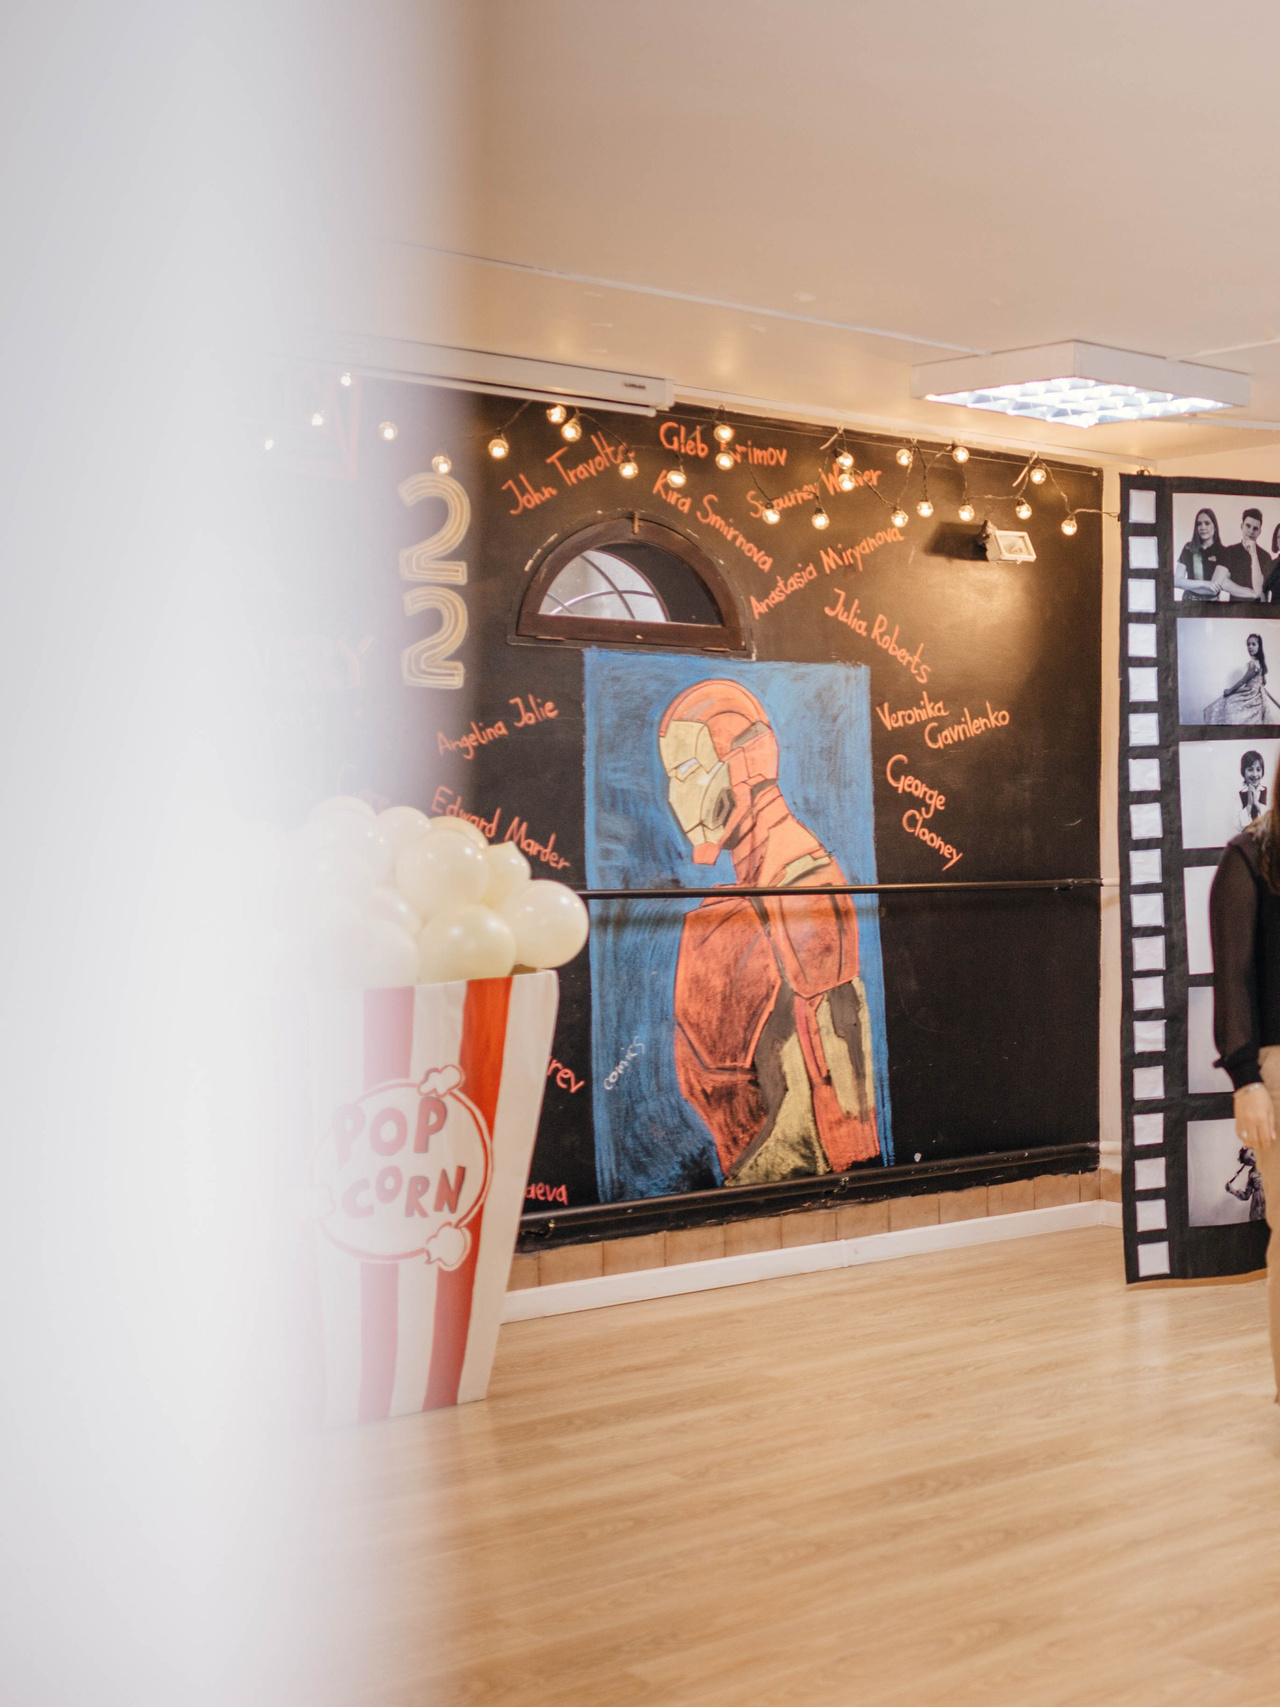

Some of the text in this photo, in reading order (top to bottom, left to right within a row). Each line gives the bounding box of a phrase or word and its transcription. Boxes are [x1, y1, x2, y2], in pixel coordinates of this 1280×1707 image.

[501, 431, 636, 515] John Travolta
[659, 421, 788, 467] Gleb rimov
[818, 463, 882, 496] Wver
[652, 469, 773, 573] Kira Smirnova
[750, 526, 904, 620] Anastasia Miryanova
[824, 588, 931, 684] Julia Roberts
[437, 694, 559, 760] Angelina Jolie
[876, 691, 949, 731] Veronika
[924, 701, 1010, 749] Gavrilenko
[886, 754, 946, 819] George
[431, 786, 502, 838] Edward
[504, 816, 571, 870] Marder
[902, 809, 963, 872] Clooney
[332, 1096, 448, 1169] POP
[342, 1165, 466, 1219] CORN
[525, 1182, 568, 1206] aeva
